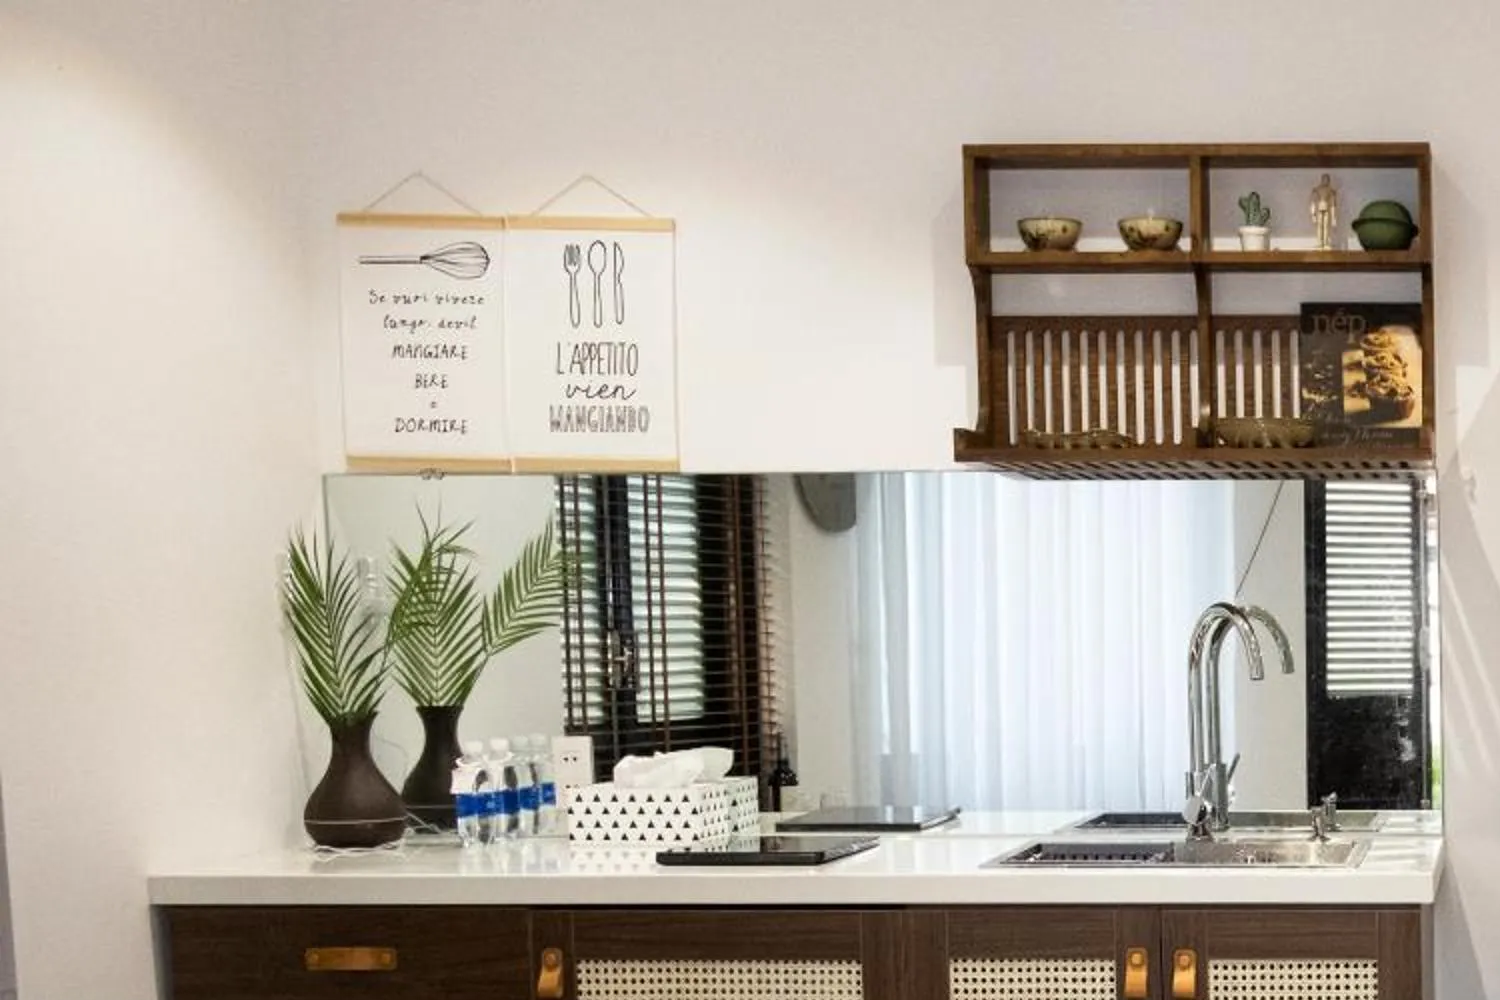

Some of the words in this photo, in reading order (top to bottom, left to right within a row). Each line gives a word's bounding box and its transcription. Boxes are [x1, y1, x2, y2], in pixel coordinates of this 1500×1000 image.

[392, 343, 469, 361] MANGIARE
[556, 340, 640, 377] L'APPETITO
[414, 372, 449, 389] BERE
[565, 379, 637, 401] vien
[394, 417, 469, 435] DORMIRE
[549, 404, 651, 433] MANGIANDO
